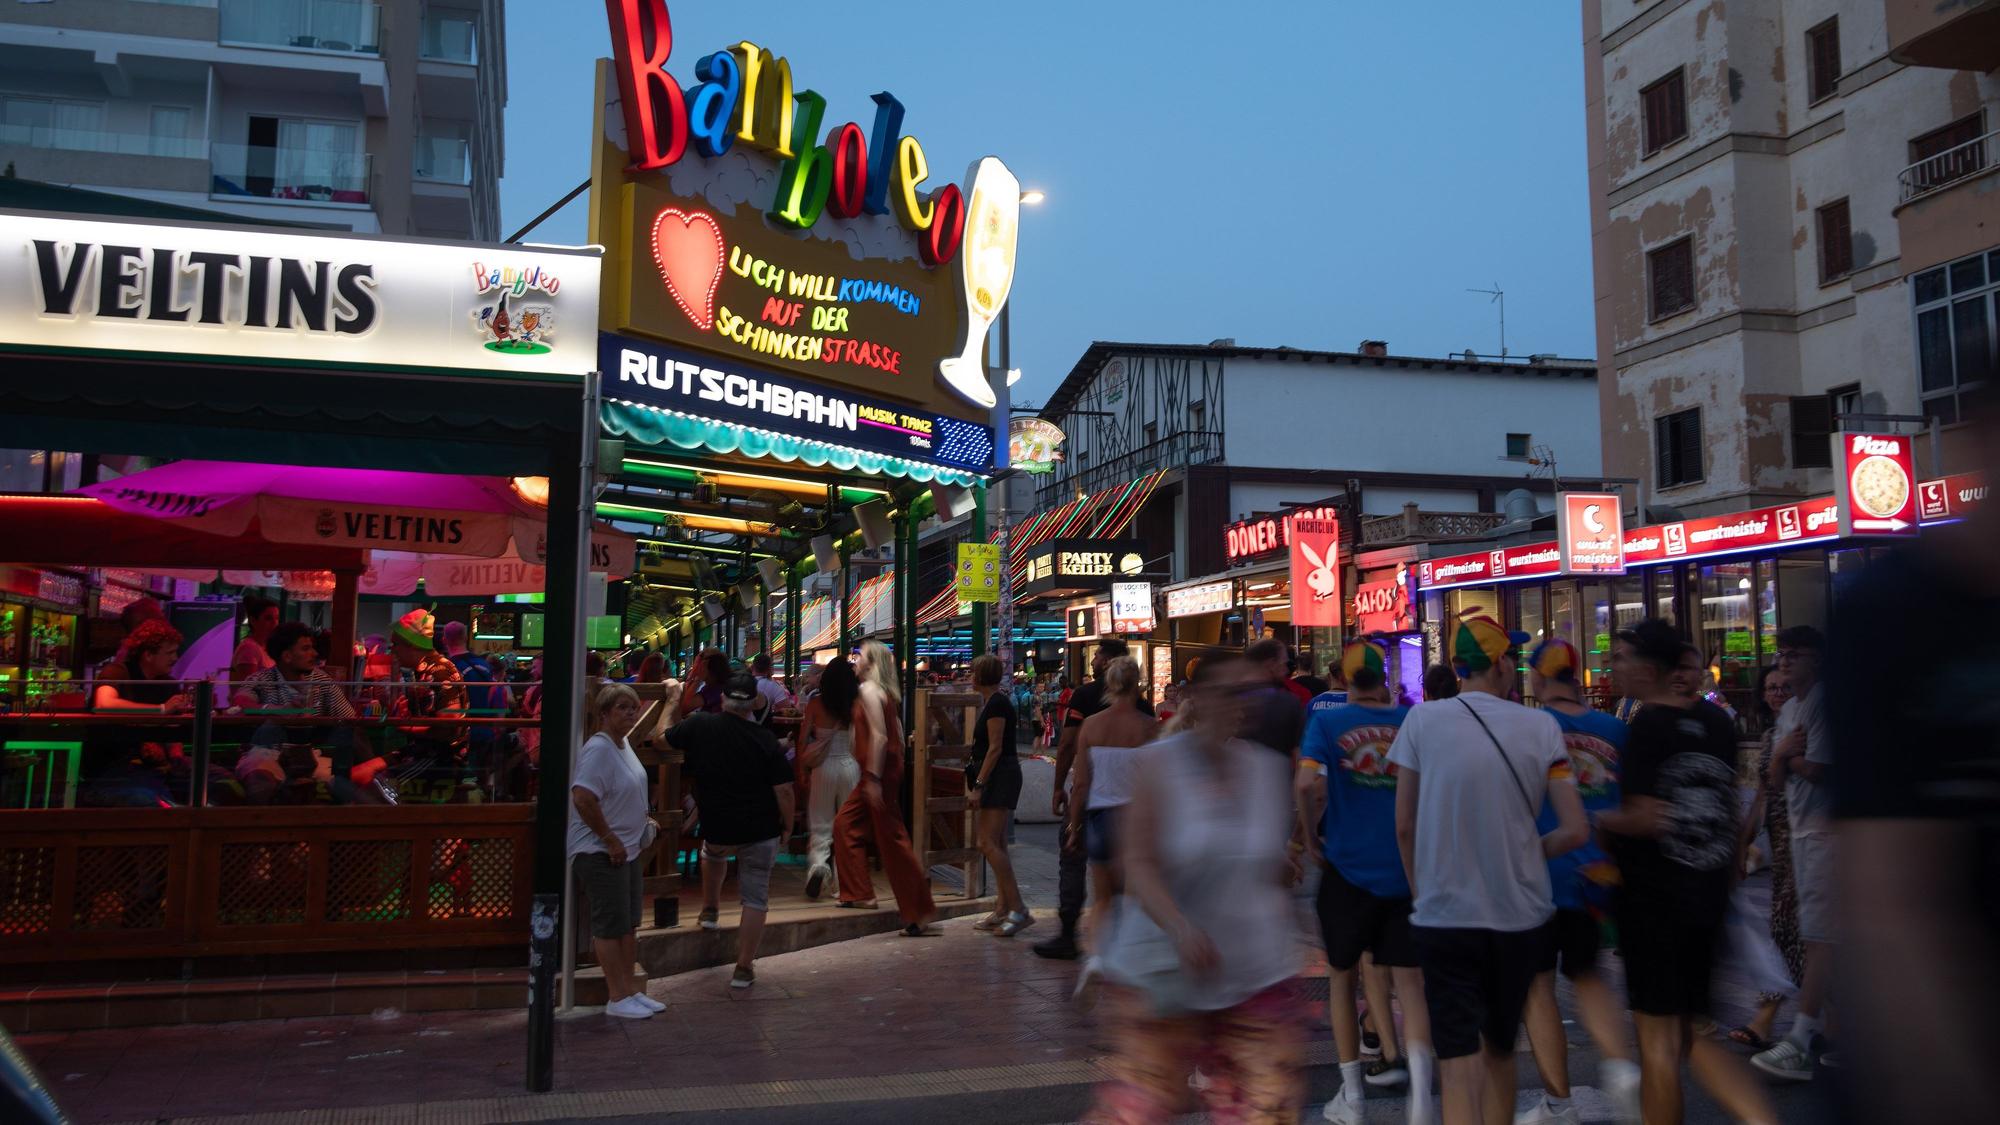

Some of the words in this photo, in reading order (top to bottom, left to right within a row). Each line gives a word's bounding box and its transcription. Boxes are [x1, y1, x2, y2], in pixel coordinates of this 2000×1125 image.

[473, 262, 561, 295] Bamboleo
[729, 245, 785, 293] LICH
[32, 239, 375, 335] VELTINS
[761, 296, 804, 327] AUF
[811, 305, 849, 333] DER
[620, 348, 857, 431] RUTSCHBAHN
[859, 405, 897, 426] MUSIK
[900, 414, 932, 433] TANZ
[1852, 435, 1900, 455] Pizza
[344, 511, 463, 545] VELTINS
[1227, 519, 1278, 558] DÖNER
[1296, 520, 1335, 534] NACHTCLUB
[1689, 518, 1768, 544] wurstmeister
[1576, 540, 1614, 550] wurst
[1061, 552, 1114, 564] PARTY
[1508, 549, 1560, 567] wurstmeiste
[1573, 552, 1620, 564] meister
[1061, 564, 1114, 576] KELLER
[1435, 561, 1485, 581] grillmeister
[1125, 603, 1137, 612] 50
